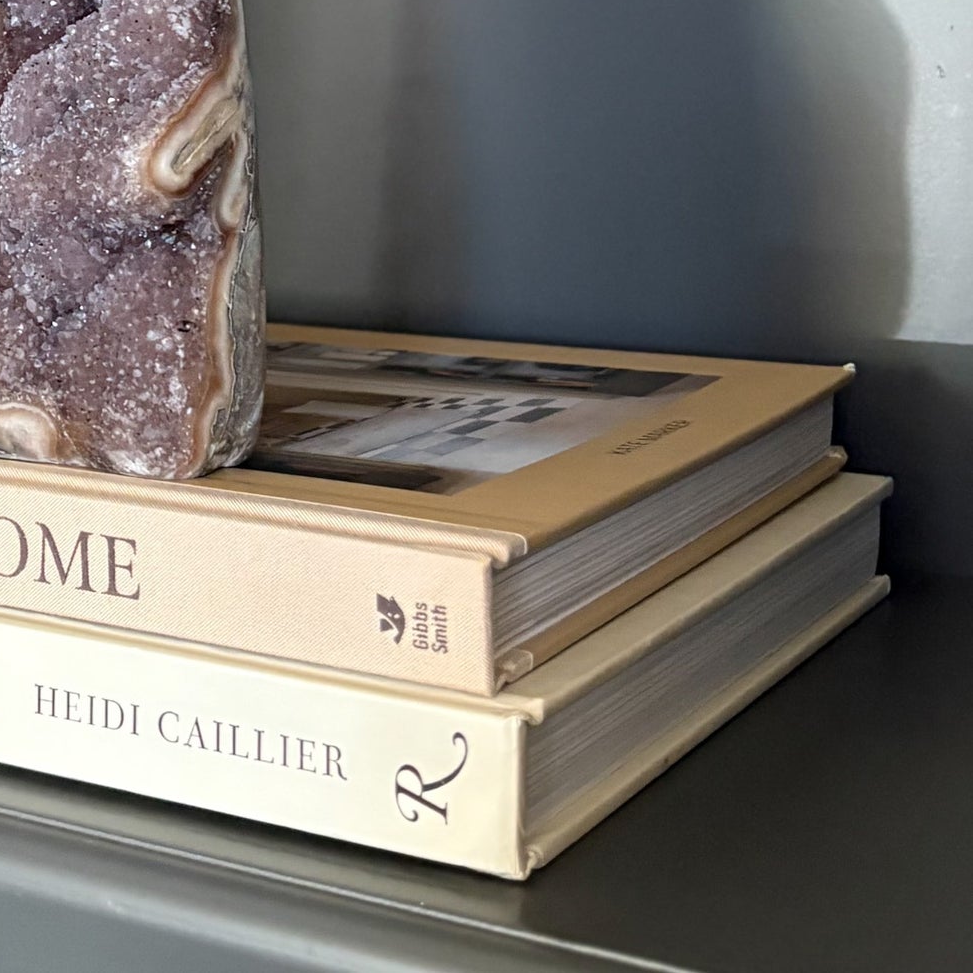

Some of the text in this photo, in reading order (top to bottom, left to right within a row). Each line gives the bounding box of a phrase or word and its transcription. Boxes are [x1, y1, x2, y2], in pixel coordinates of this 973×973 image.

[412, 601, 429, 651] Gibbs
[430, 604, 449, 655] Smith
[33, 683, 348, 782] HEIDI CAILLIER
